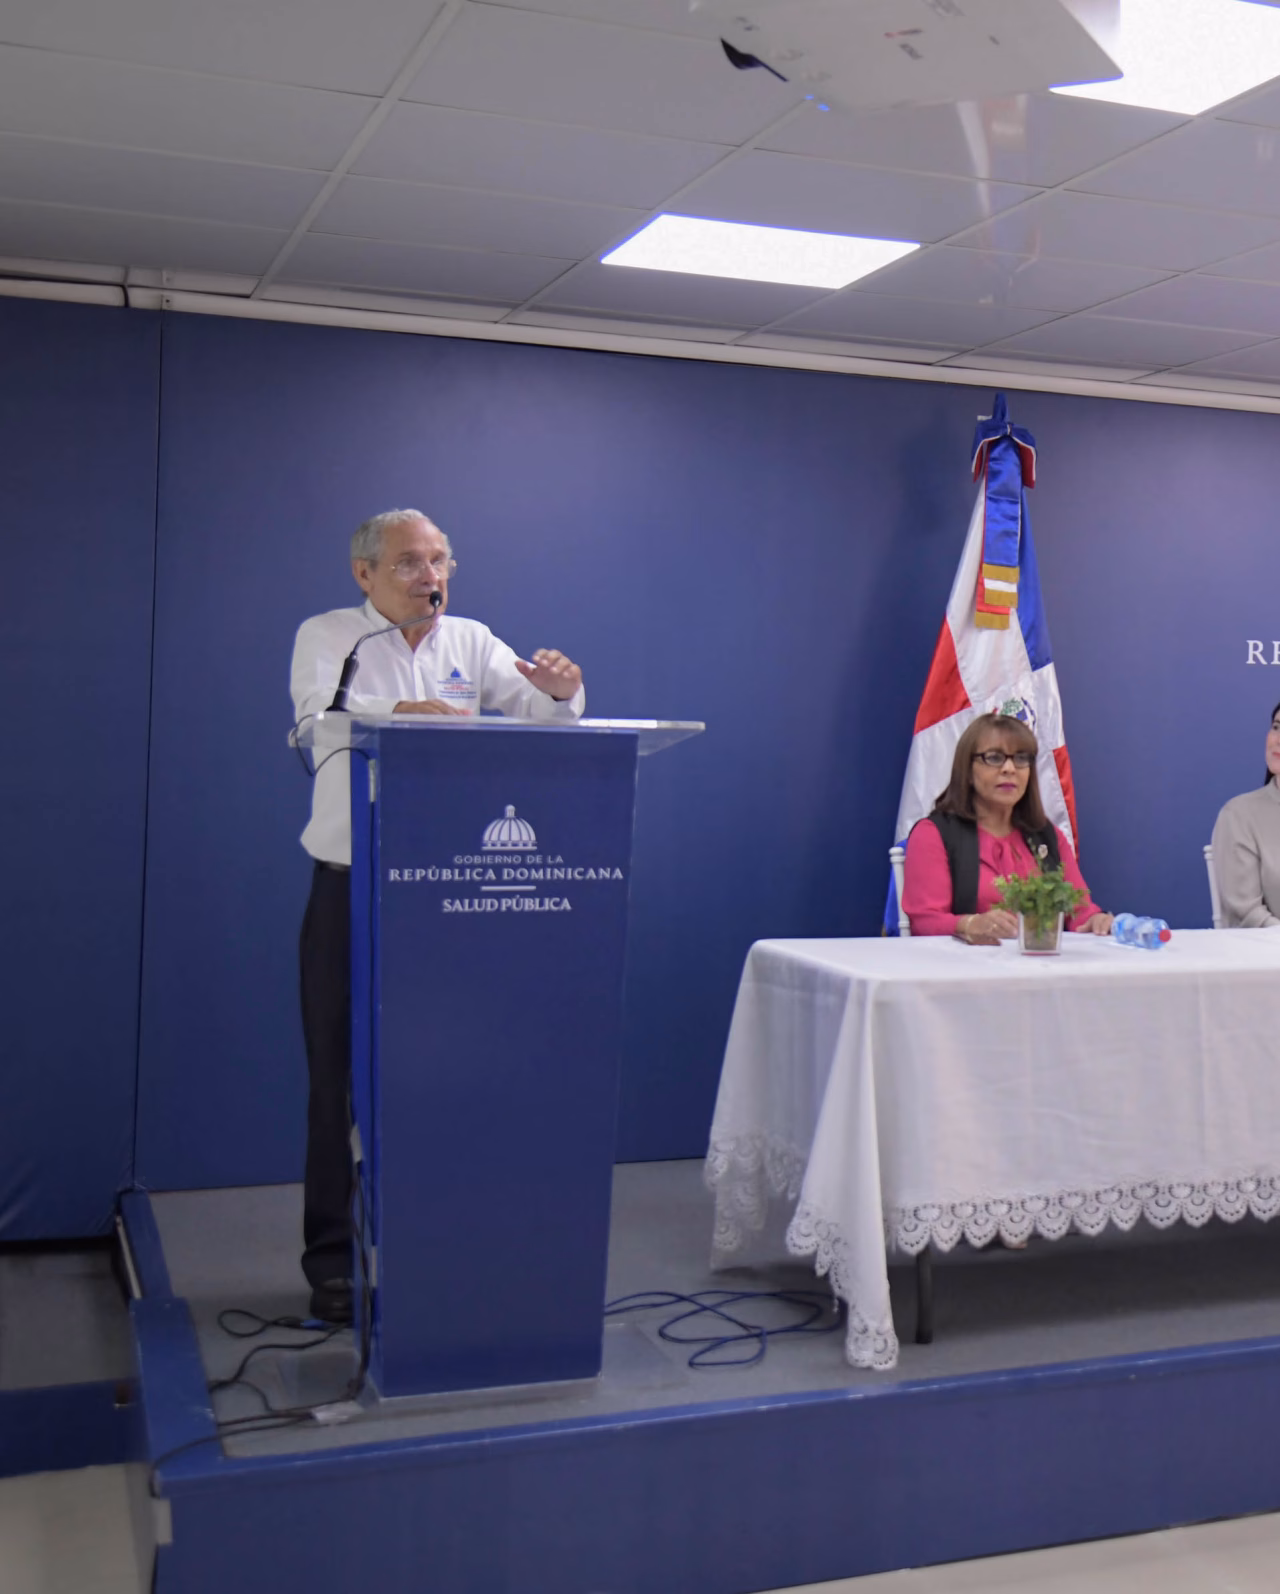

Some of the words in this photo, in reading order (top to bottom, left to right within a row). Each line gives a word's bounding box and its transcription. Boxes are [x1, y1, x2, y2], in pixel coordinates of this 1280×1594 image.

[453, 855, 522, 865] GOBIERNO
[527, 854, 543, 864] DE
[548, 854, 564, 864] LA
[388, 865, 497, 881] REPÚBLICA
[502, 867, 624, 880] DOMINICANA
[442, 898, 499, 912] SALUD
[501, 894, 572, 911] PÚBLICA
